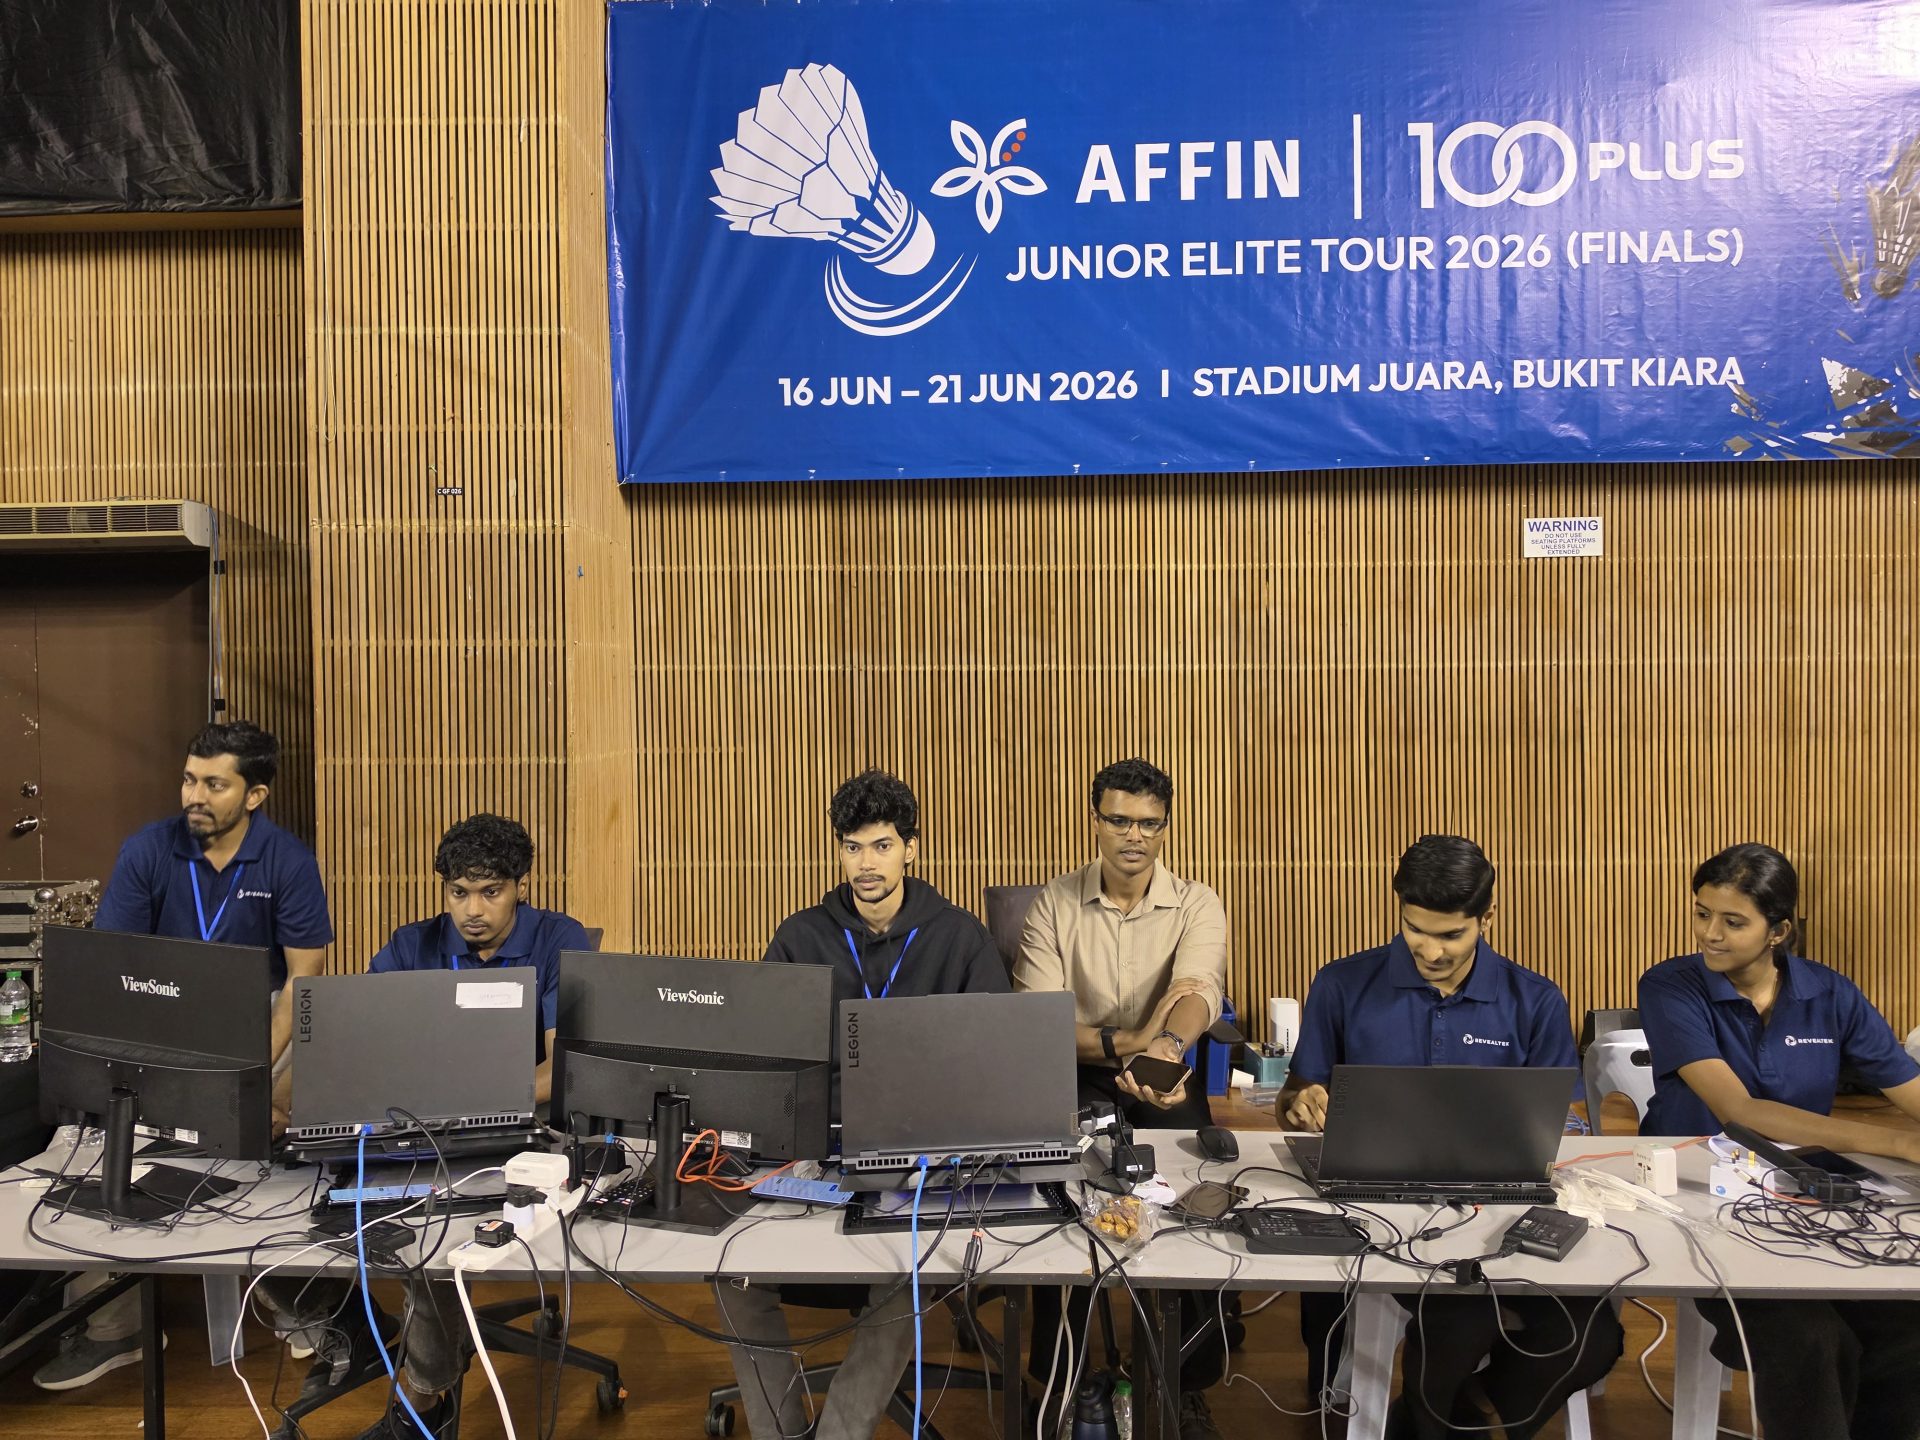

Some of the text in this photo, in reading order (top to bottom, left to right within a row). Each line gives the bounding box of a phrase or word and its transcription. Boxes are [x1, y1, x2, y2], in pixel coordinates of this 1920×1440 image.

[1076, 140, 1299, 203] AFFIN
[1589, 138, 1744, 182] PLUS
[1006, 228, 1744, 282] JUNIOR ELITE TOUR 2026 (FINALS)
[778, 377, 814, 406] 16
[820, 376, 891, 406] JUN
[928, 374, 962, 404] 21
[969, 373, 1041, 403] JUN
[1049, 371, 1138, 401] 2026
[1193, 363, 1360, 397] STADIUM
[1368, 360, 1503, 395] JUARA,
[1513, 358, 1620, 388] BUKIT
[1631, 356, 1745, 387] KIARA
[1528, 520, 1599, 532] WARNING
[121, 975, 180, 998] ViewSonic
[657, 987, 724, 1005] ViewSonic
[300, 988, 312, 1043] LEGION
[847, 1012, 860, 1068] LEGION
